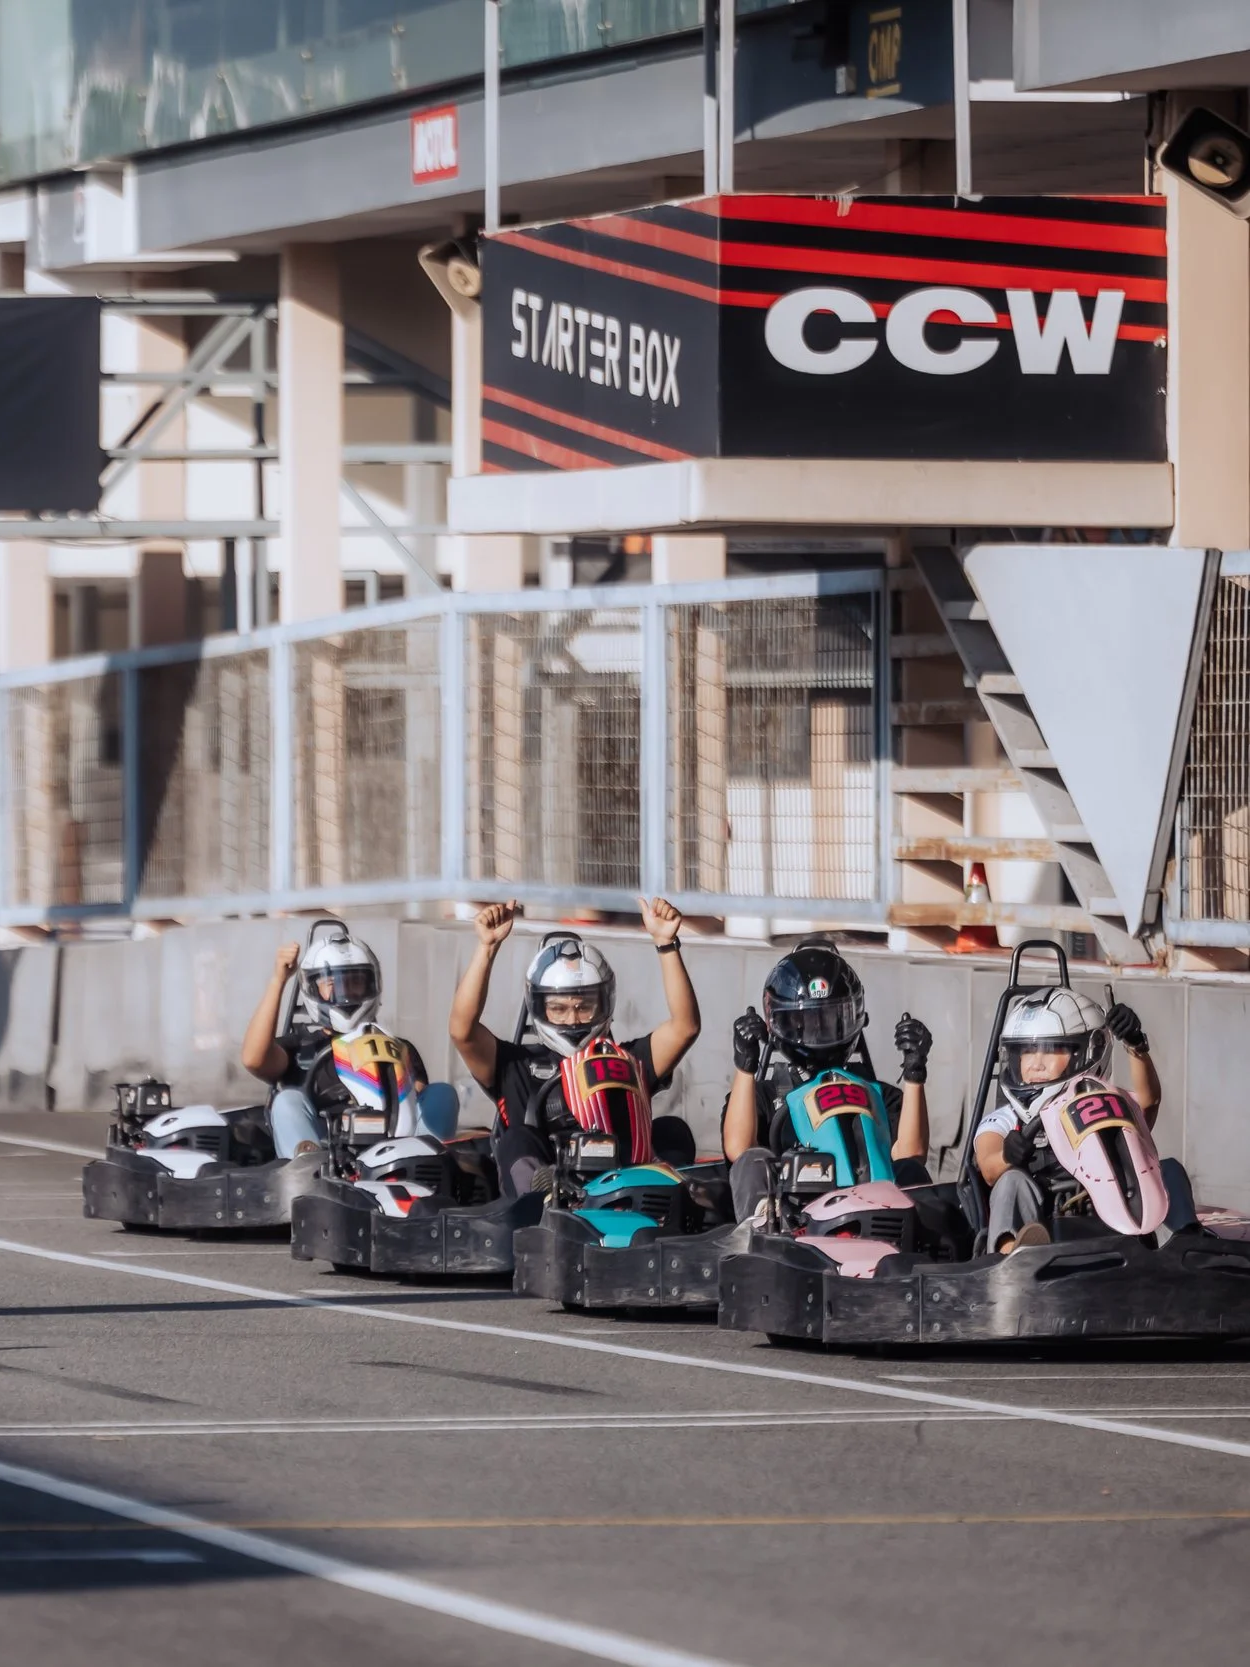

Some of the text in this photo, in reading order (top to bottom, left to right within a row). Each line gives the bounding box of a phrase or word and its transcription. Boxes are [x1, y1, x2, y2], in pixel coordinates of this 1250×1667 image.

[765, 286, 1125, 374] CCW
[511, 287, 681, 408] STARTER BOX
[364, 1039, 402, 1059] 16
[591, 1059, 630, 1081] 19
[816, 1083, 869, 1111] 29
[1075, 1094, 1124, 1125] 21
